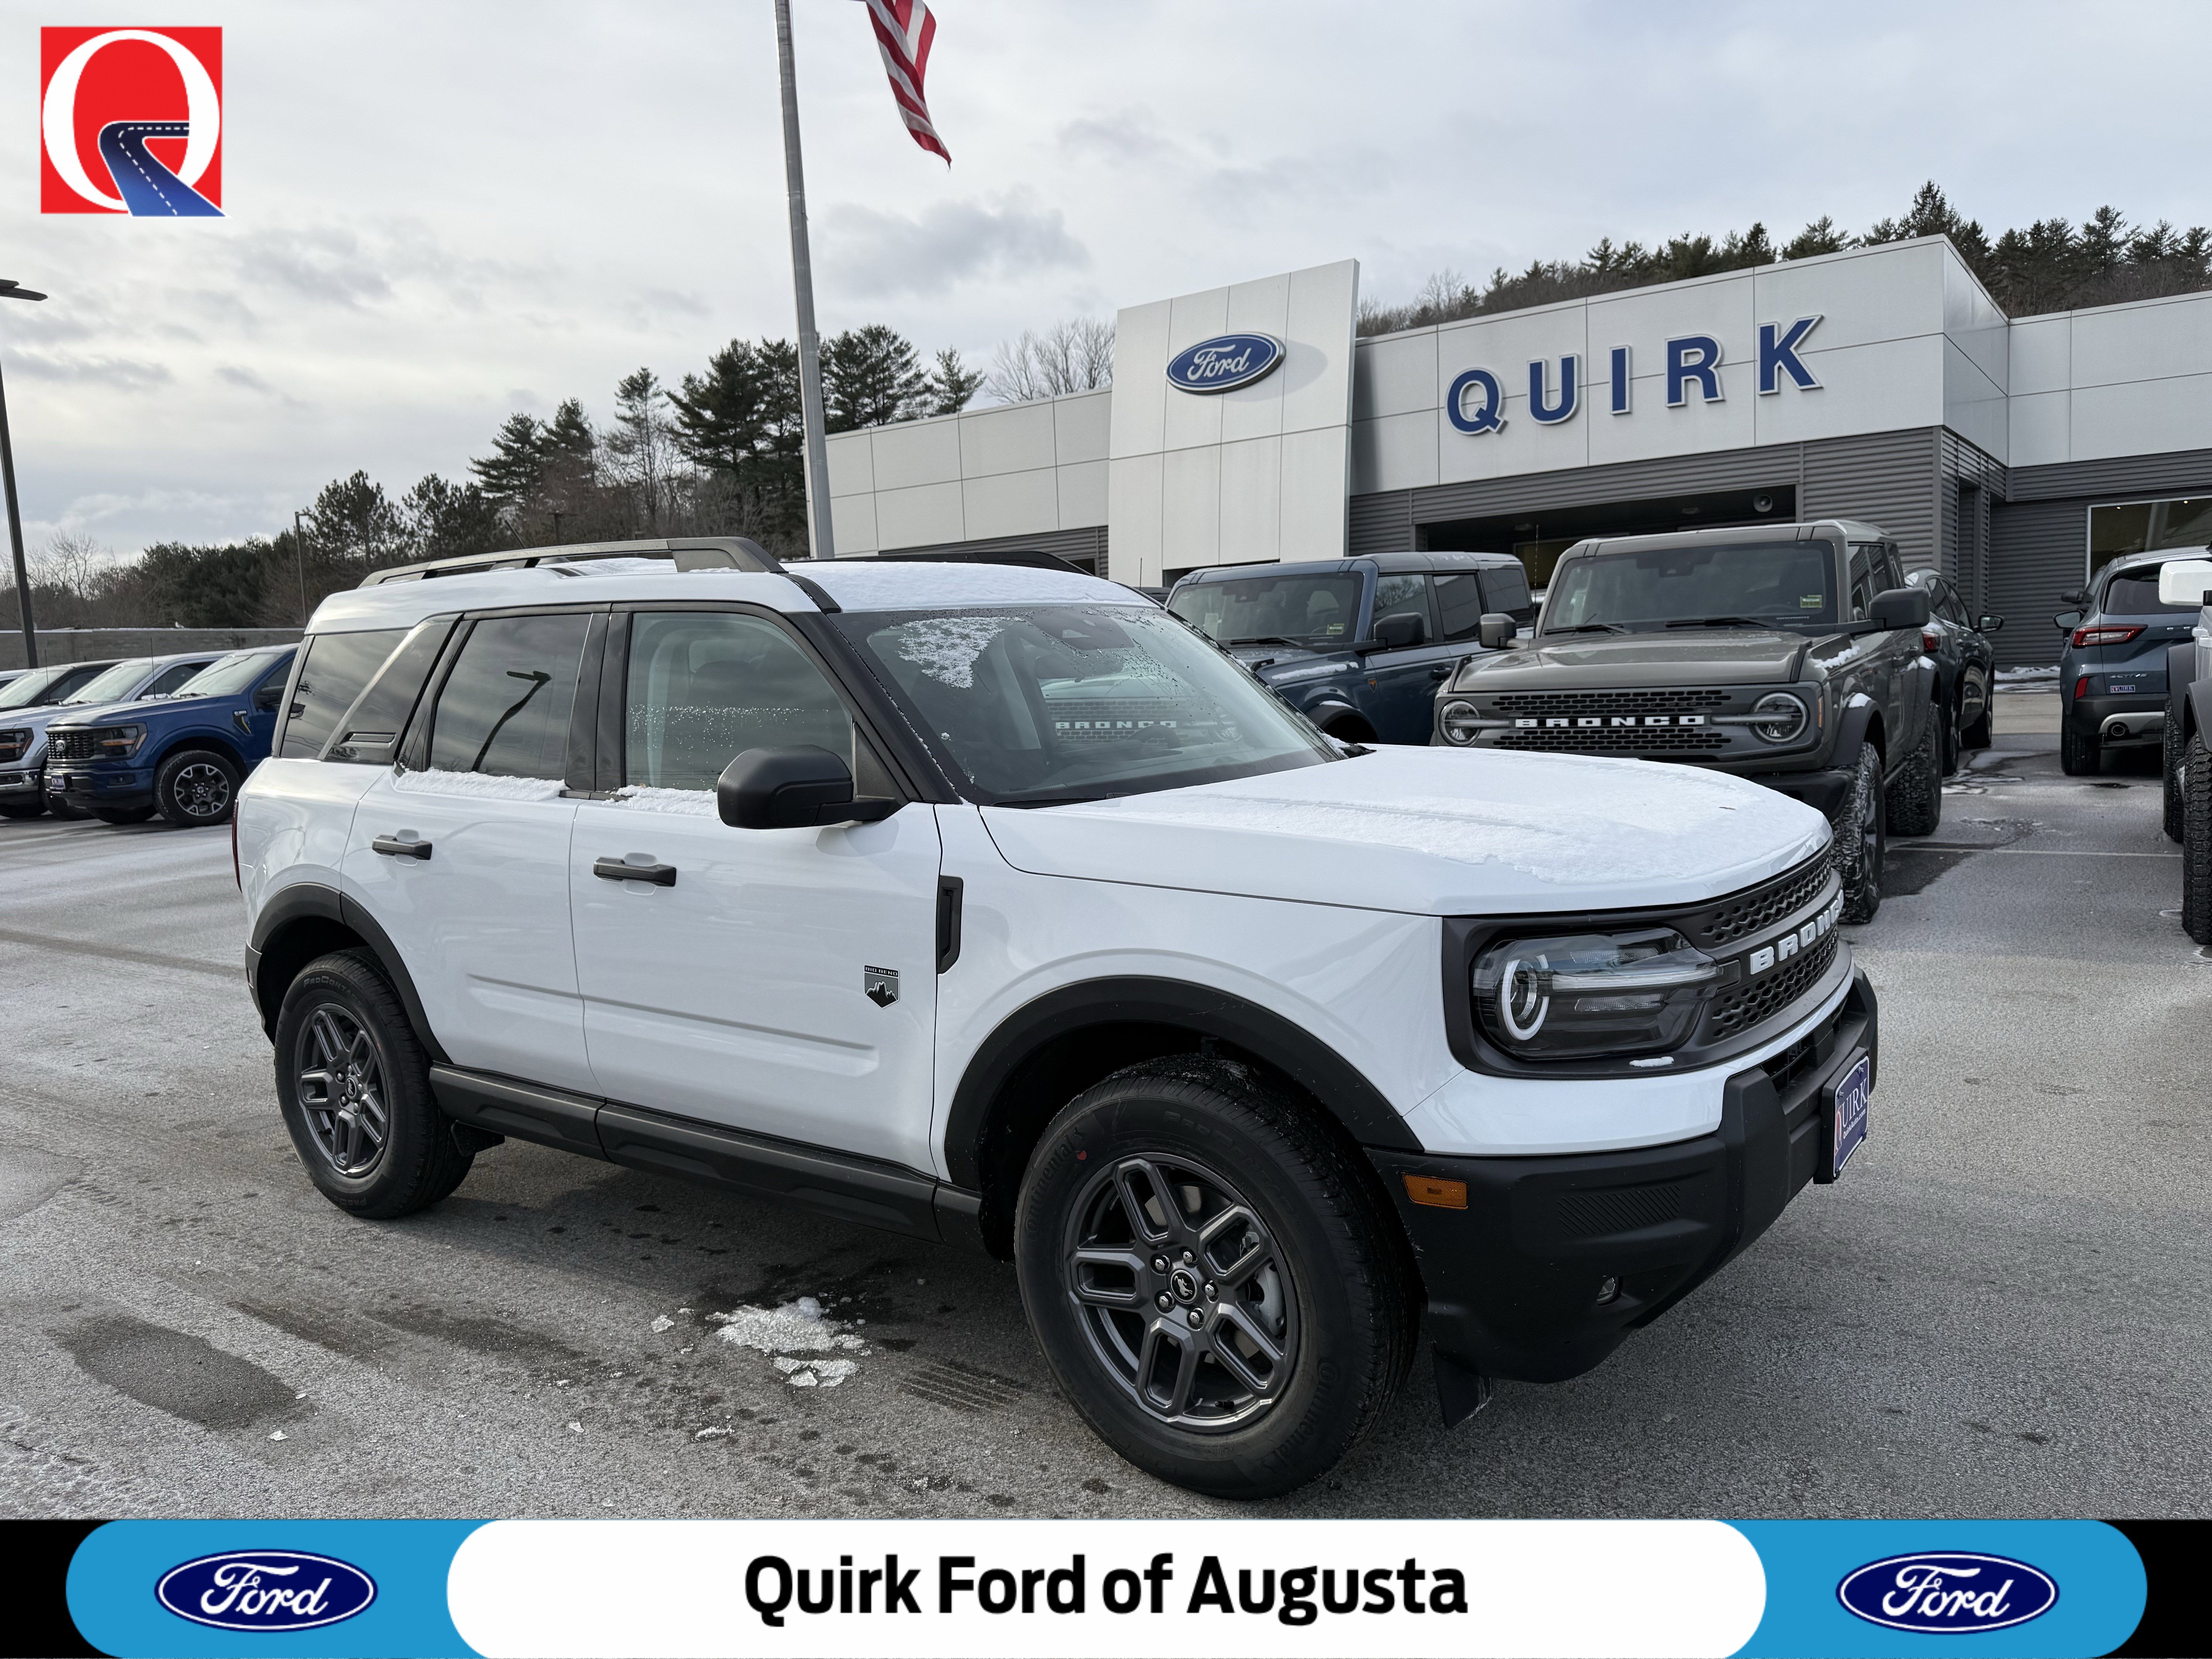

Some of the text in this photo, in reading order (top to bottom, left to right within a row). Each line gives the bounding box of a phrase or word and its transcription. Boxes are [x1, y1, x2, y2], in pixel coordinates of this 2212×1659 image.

[1187, 343, 1252, 381] Ford
[1445, 314, 1824, 435] QUIRK
[1056, 721, 1177, 729] BRONCO
[1515, 715, 1704, 728] BRONCO
